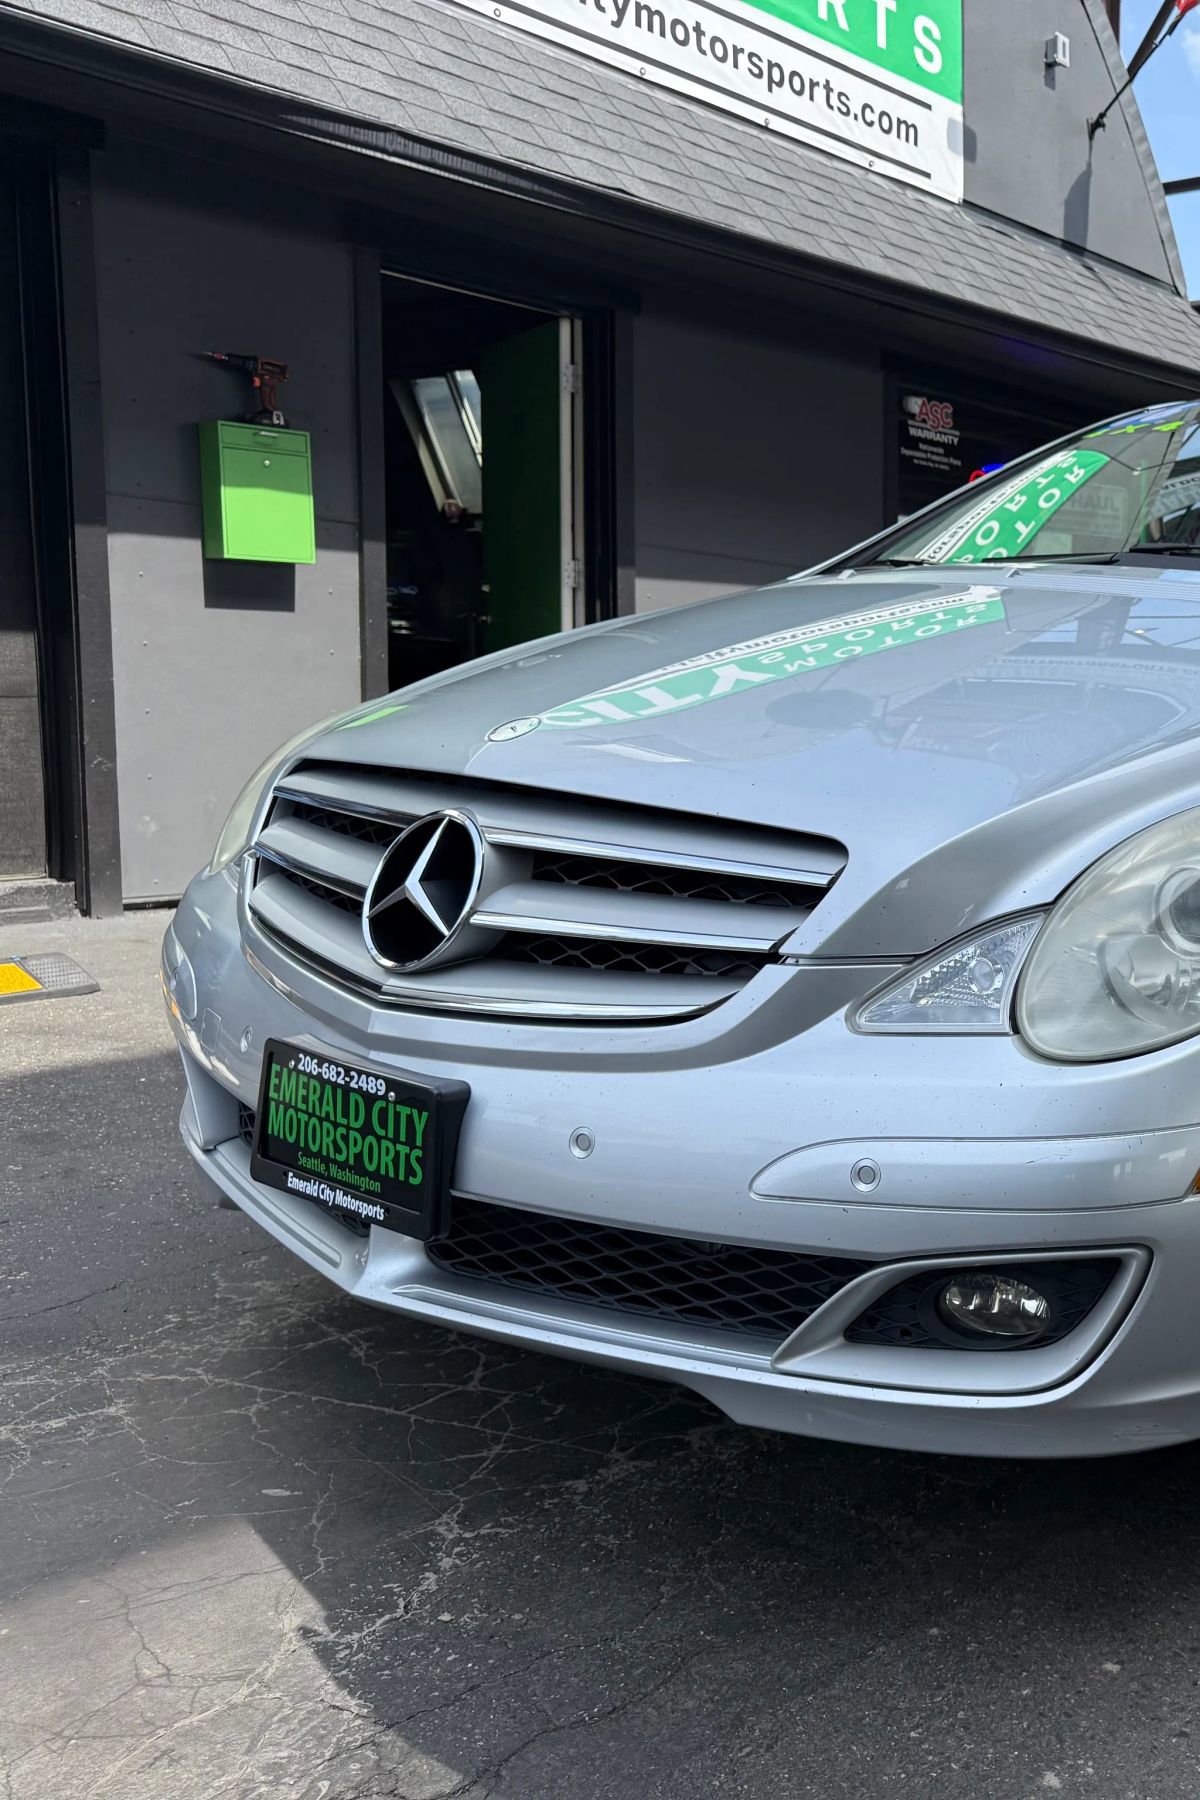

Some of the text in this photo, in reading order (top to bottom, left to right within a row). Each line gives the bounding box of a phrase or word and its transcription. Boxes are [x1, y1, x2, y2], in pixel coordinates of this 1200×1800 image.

[915, 398, 953, 430] ASC
[908, 426, 959, 446] WARRANTY
[298, 1053, 386, 1096] 206-682-2489
[268, 1062, 429, 1147] EMERALD CITY
[267, 1101, 424, 1185] MOTORSPORTS
[297, 1151, 381, 1193] Seattle, Washington
[287, 1171, 385, 1221] Emerald City Motorsports
